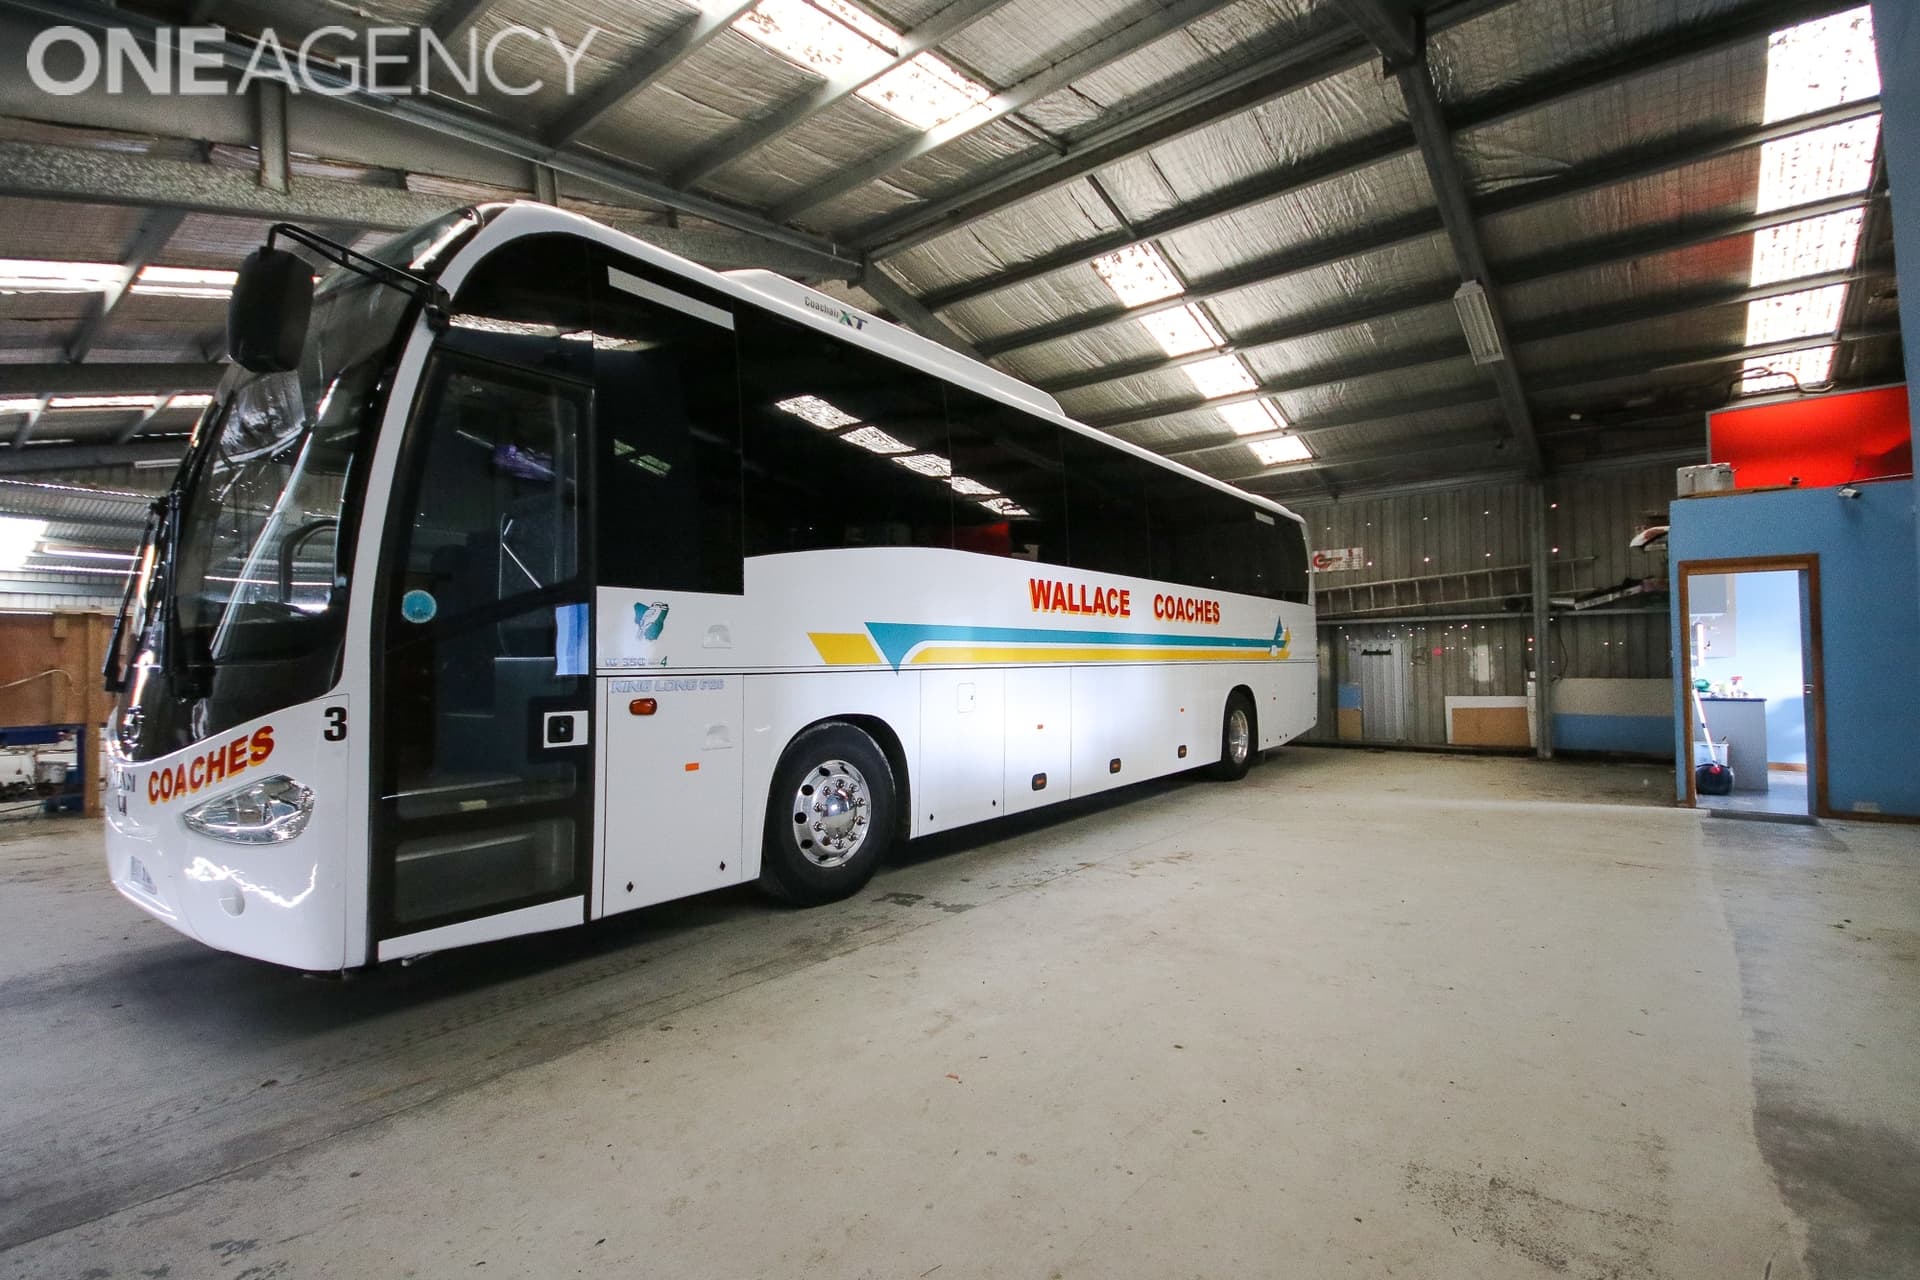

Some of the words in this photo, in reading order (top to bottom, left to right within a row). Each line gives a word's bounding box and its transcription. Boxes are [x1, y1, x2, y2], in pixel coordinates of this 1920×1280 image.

[1029, 578, 1131, 617] WALLACE
[1153, 593, 1220, 624] COACHES
[611, 680, 650, 694] KING
[654, 679, 697, 692] LONG
[323, 706, 347, 741] 3
[147, 725, 276, 805] COACHES
